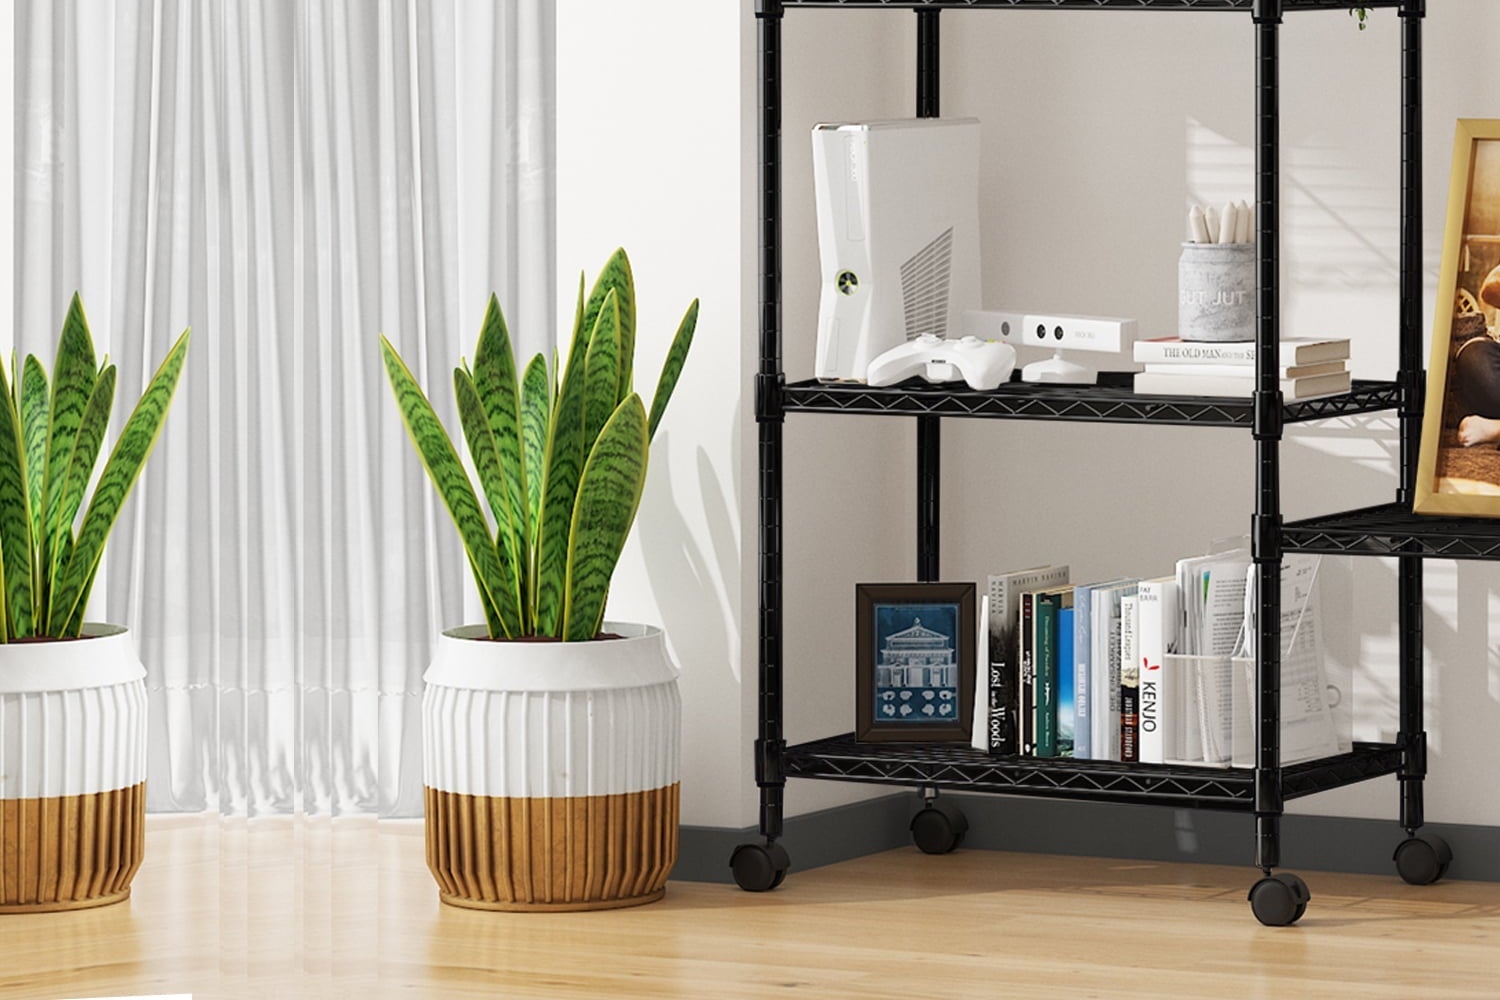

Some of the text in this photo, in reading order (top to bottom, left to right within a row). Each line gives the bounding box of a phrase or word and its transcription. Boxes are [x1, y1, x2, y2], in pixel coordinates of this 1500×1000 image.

[1212, 290, 1247, 306] JUT
[1162, 347, 1181, 358] THE
[1181, 347, 1201, 358] OLD
[1201, 348, 1222, 359] MAN
[1245, 350, 1256, 360] SE
[990, 661, 1005, 688] Lost
[1141, 681, 1157, 733] KENJO
[990, 706, 1005, 748] Woods
